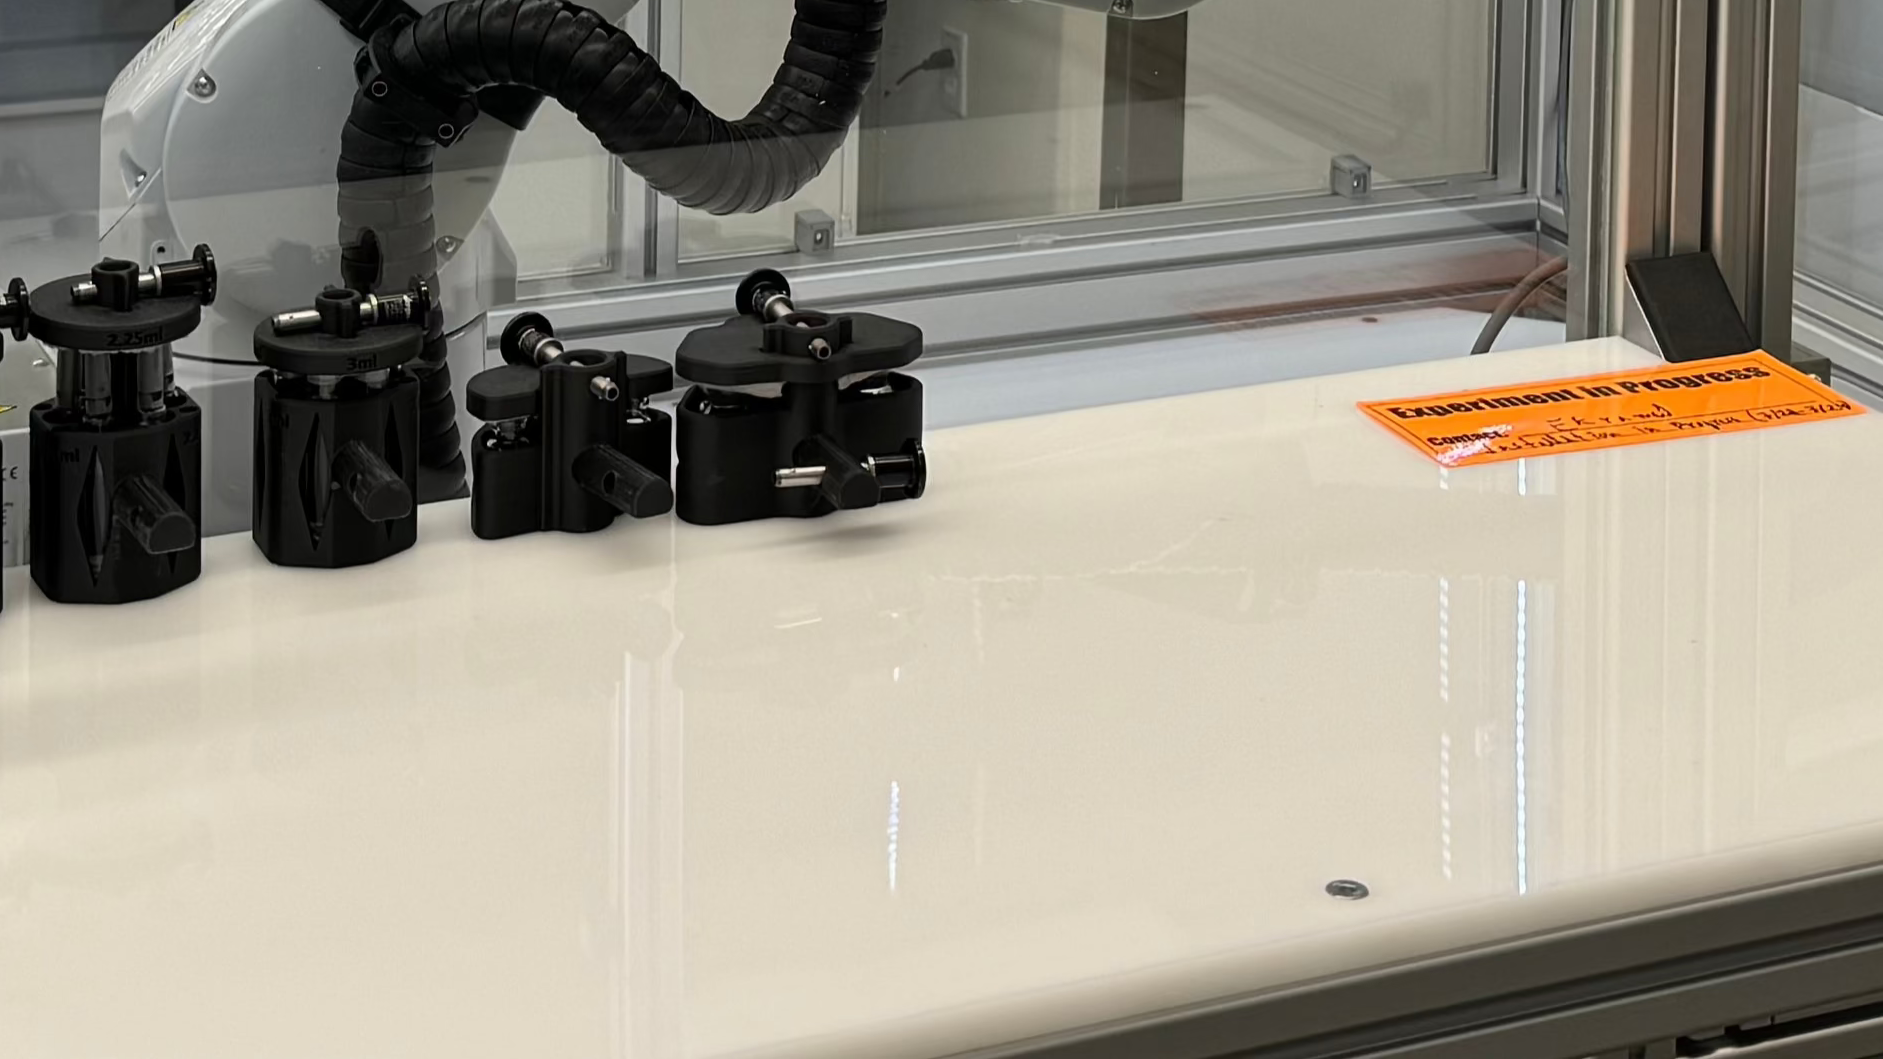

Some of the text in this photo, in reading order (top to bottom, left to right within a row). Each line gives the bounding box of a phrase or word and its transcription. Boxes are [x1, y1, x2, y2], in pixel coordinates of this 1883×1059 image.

[346, 353, 377, 371] 3ml
[1388, 366, 1771, 419] Experiment in Progress
